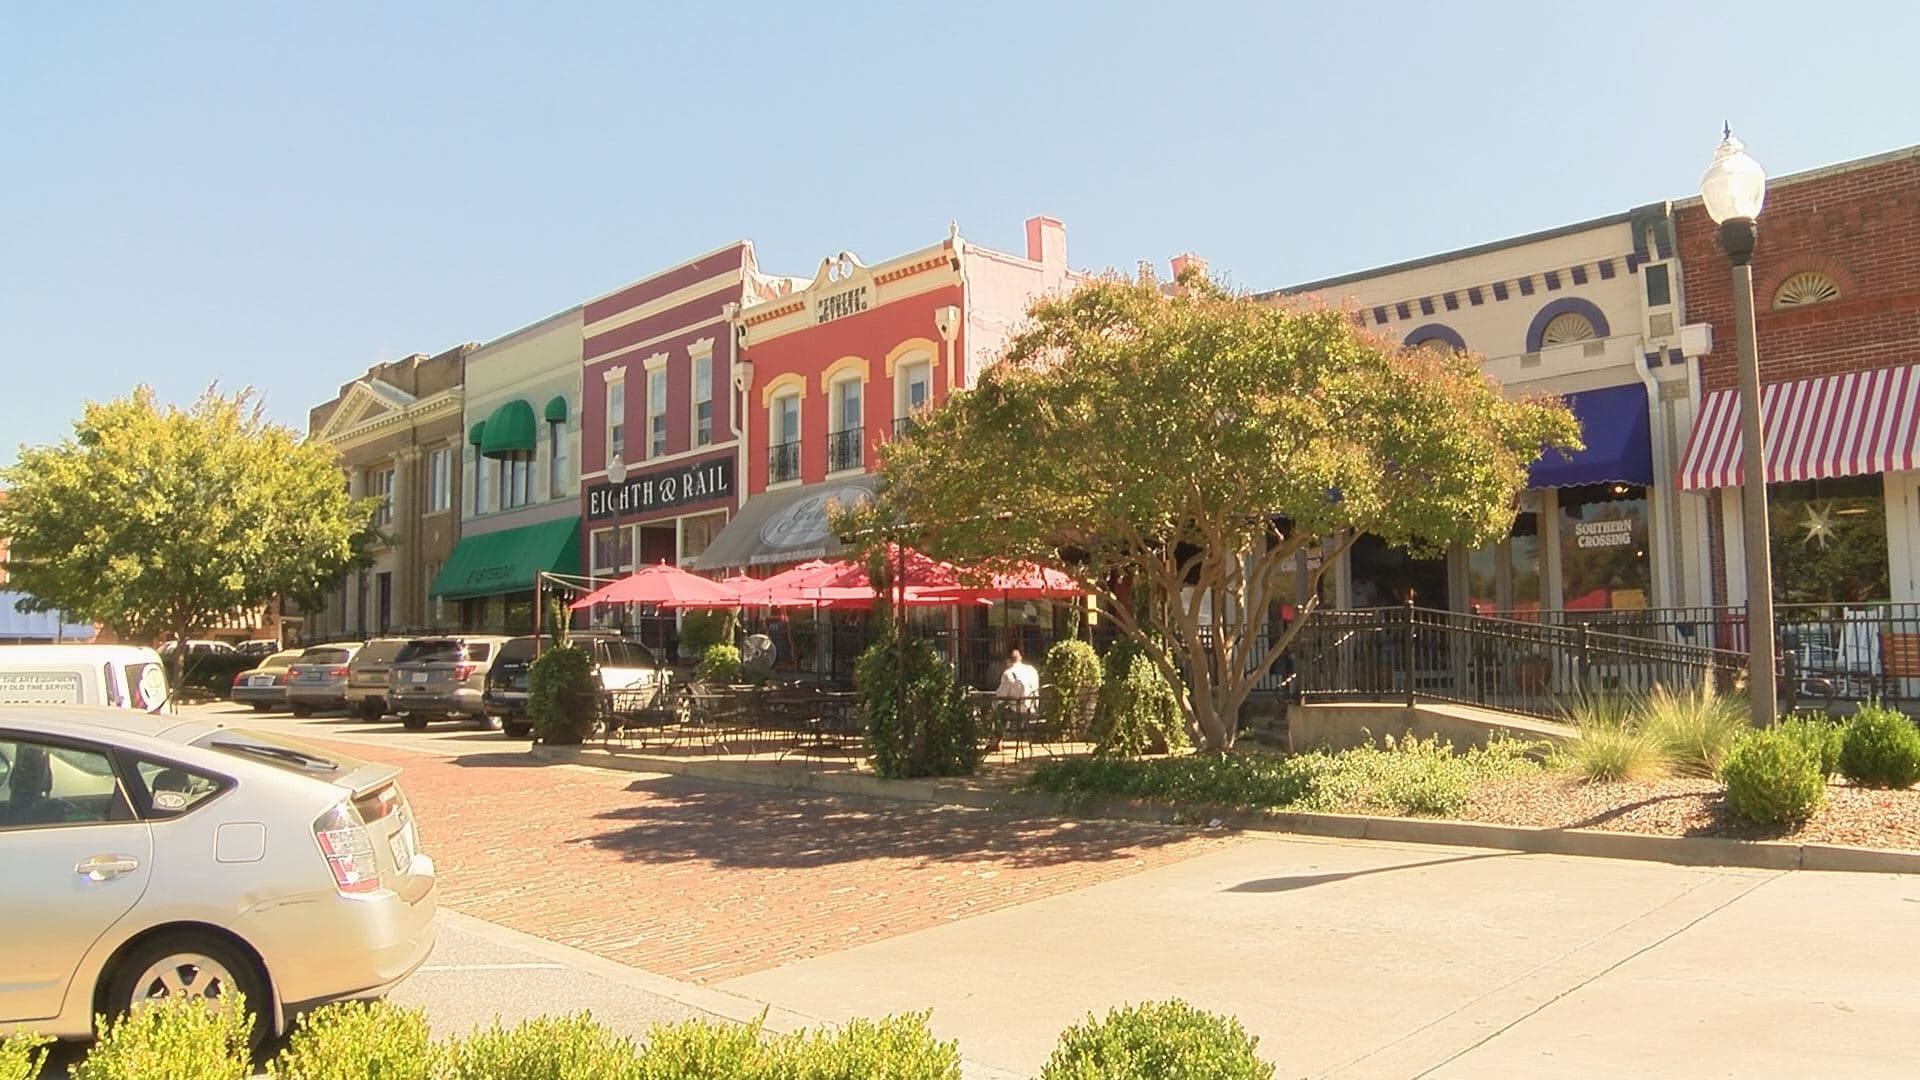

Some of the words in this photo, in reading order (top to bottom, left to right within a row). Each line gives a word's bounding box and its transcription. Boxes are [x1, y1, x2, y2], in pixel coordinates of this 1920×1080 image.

[818, 301, 867, 323] BUILDING
[659, 477, 676, 502] &
[683, 466, 727, 498] RAIL
[1575, 520, 1631, 535] SOUTHERN
[1578, 533, 1631, 547] CROSSING
